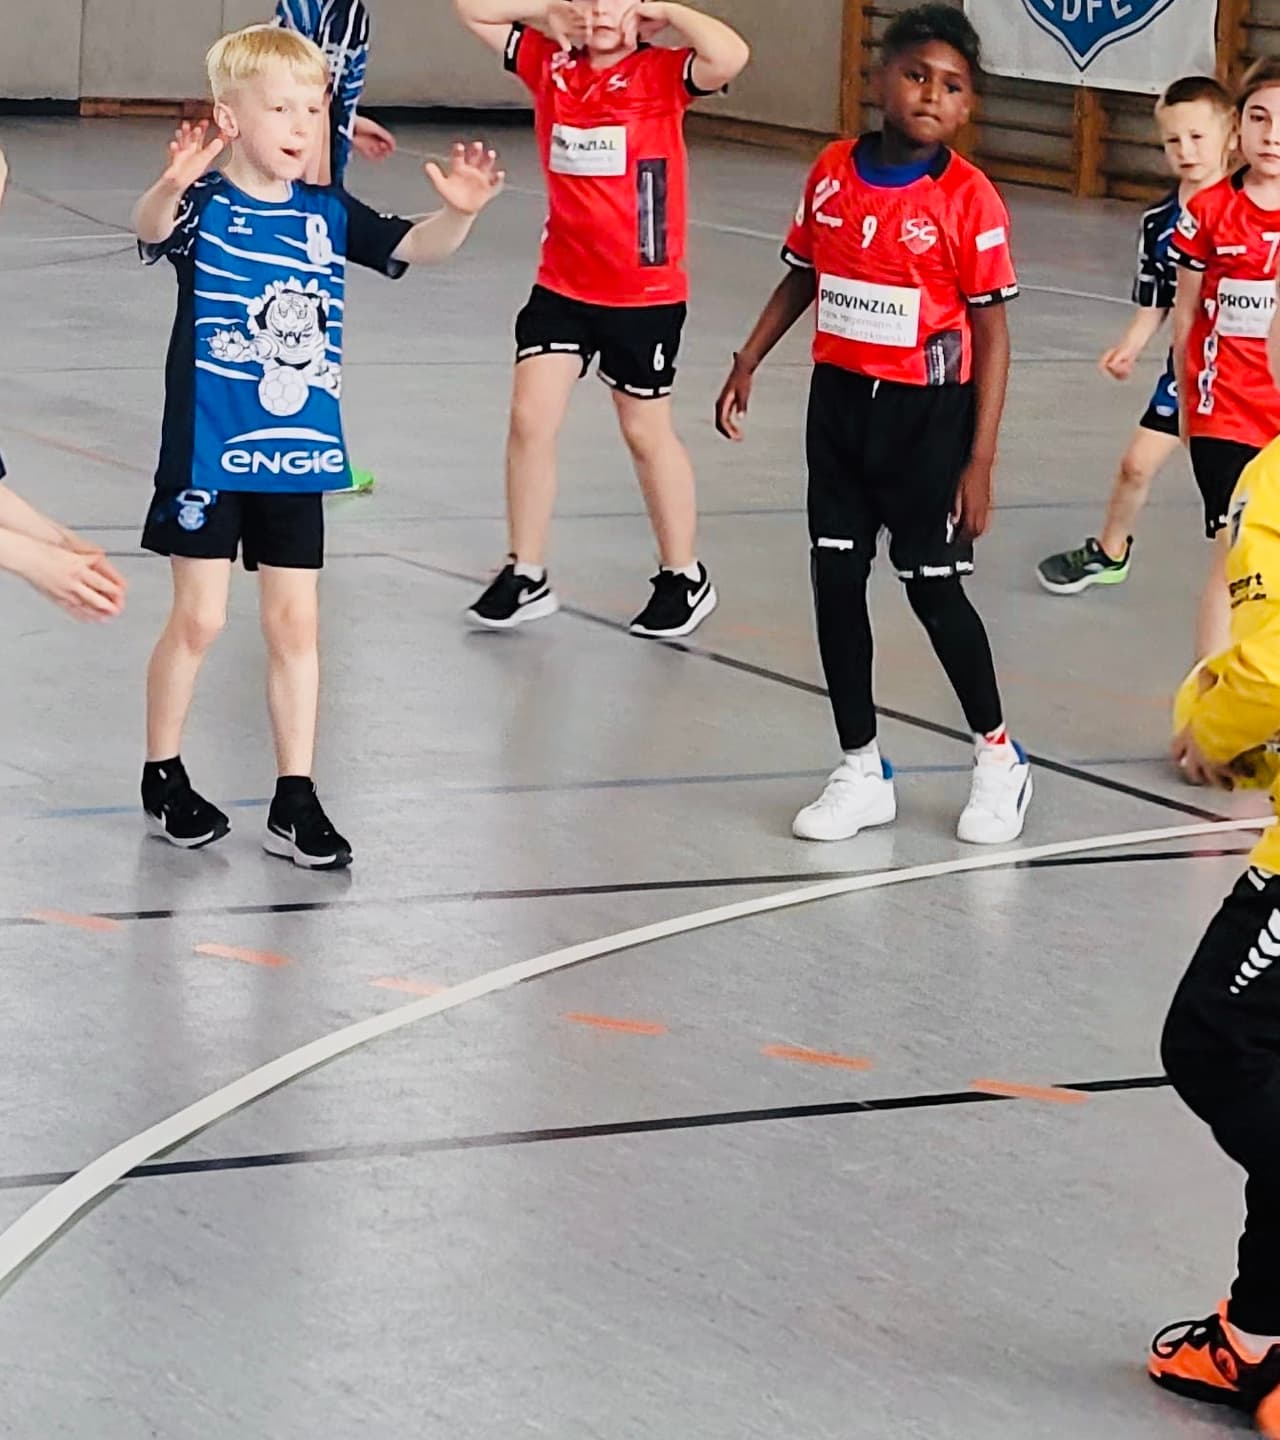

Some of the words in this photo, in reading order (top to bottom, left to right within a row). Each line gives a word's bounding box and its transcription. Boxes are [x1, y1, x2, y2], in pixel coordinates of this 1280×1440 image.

[860, 214, 878, 249] 9
[820, 288, 909, 318] PROVINZIAL
[652, 342, 666, 372] 6
